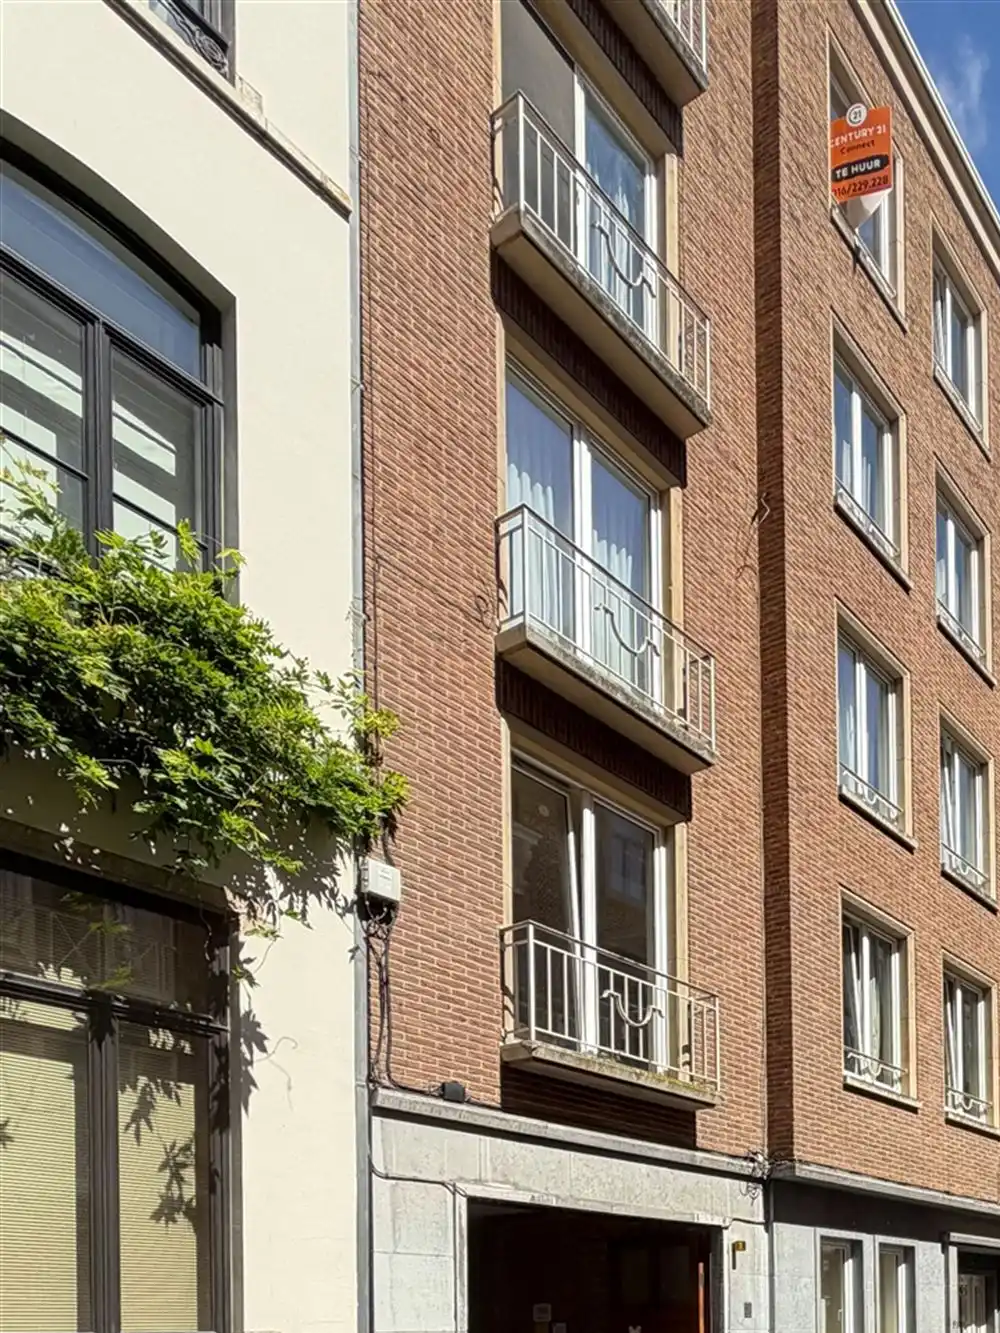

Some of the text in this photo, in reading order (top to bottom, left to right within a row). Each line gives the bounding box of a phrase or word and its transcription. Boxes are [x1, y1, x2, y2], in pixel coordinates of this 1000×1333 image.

[877, 124, 887, 135] 21
[835, 158, 881, 179] TE HUUR
